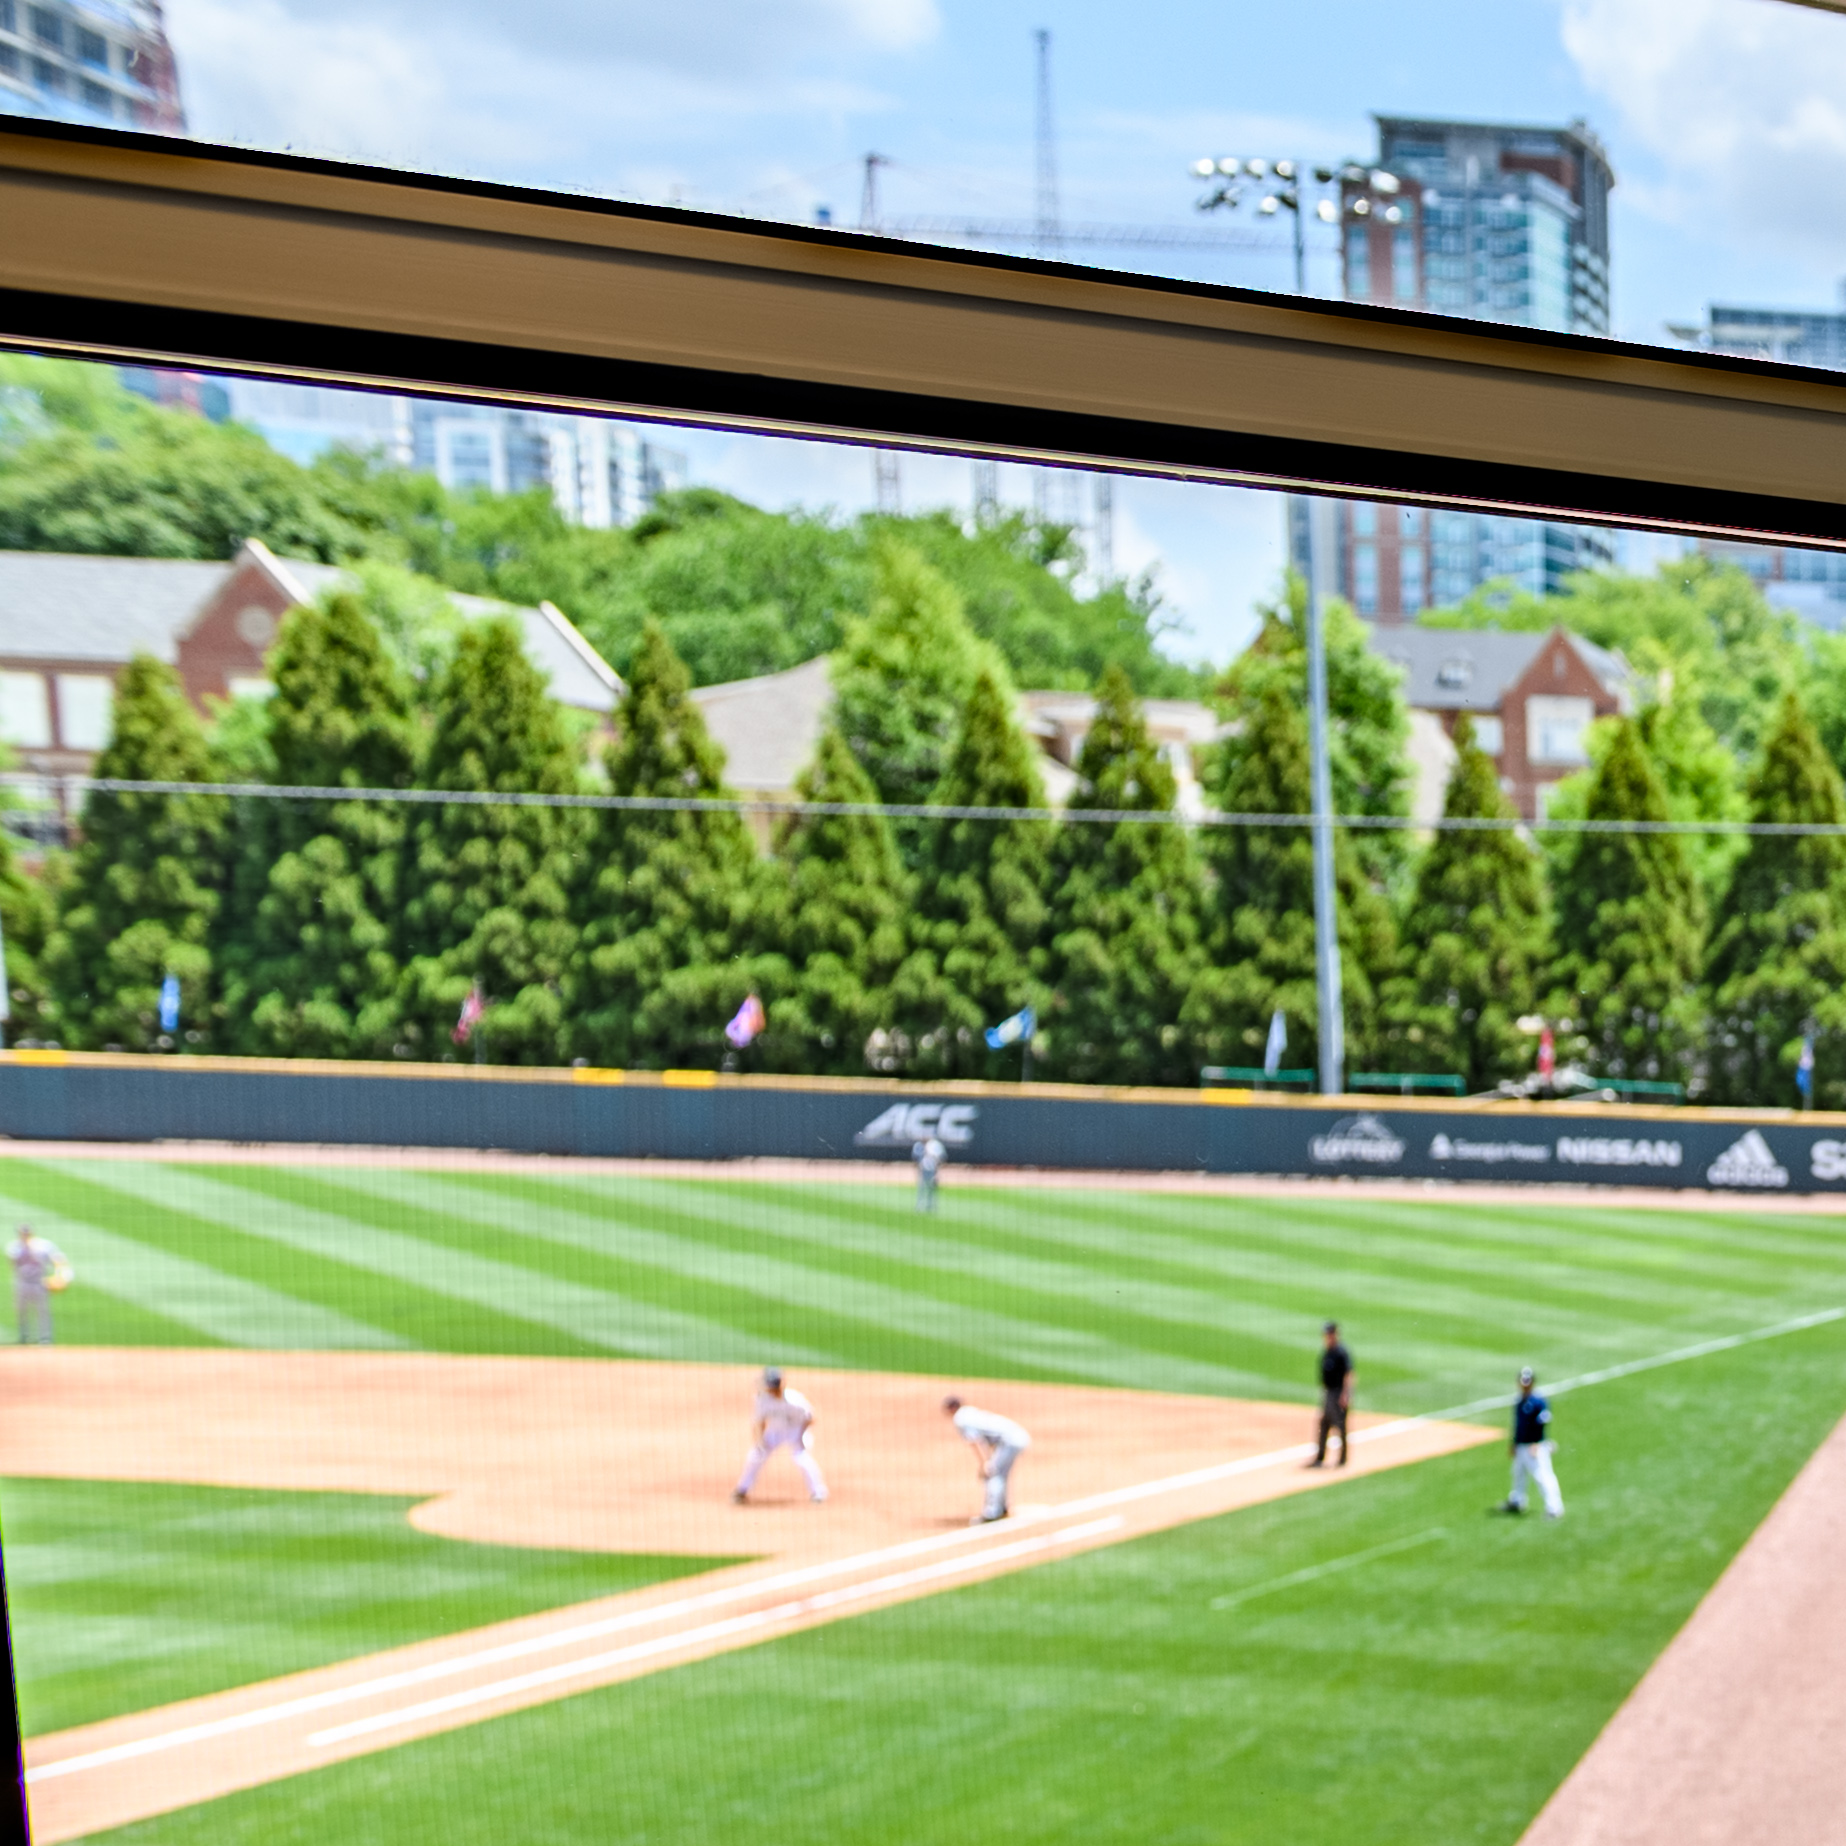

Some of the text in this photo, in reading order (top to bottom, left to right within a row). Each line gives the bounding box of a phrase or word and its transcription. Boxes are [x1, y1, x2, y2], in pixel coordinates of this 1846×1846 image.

[854, 1102, 980, 1147] ACC
[1556, 1136, 1683, 1167] NISSAN
[1706, 1164, 1789, 1187] adidas
